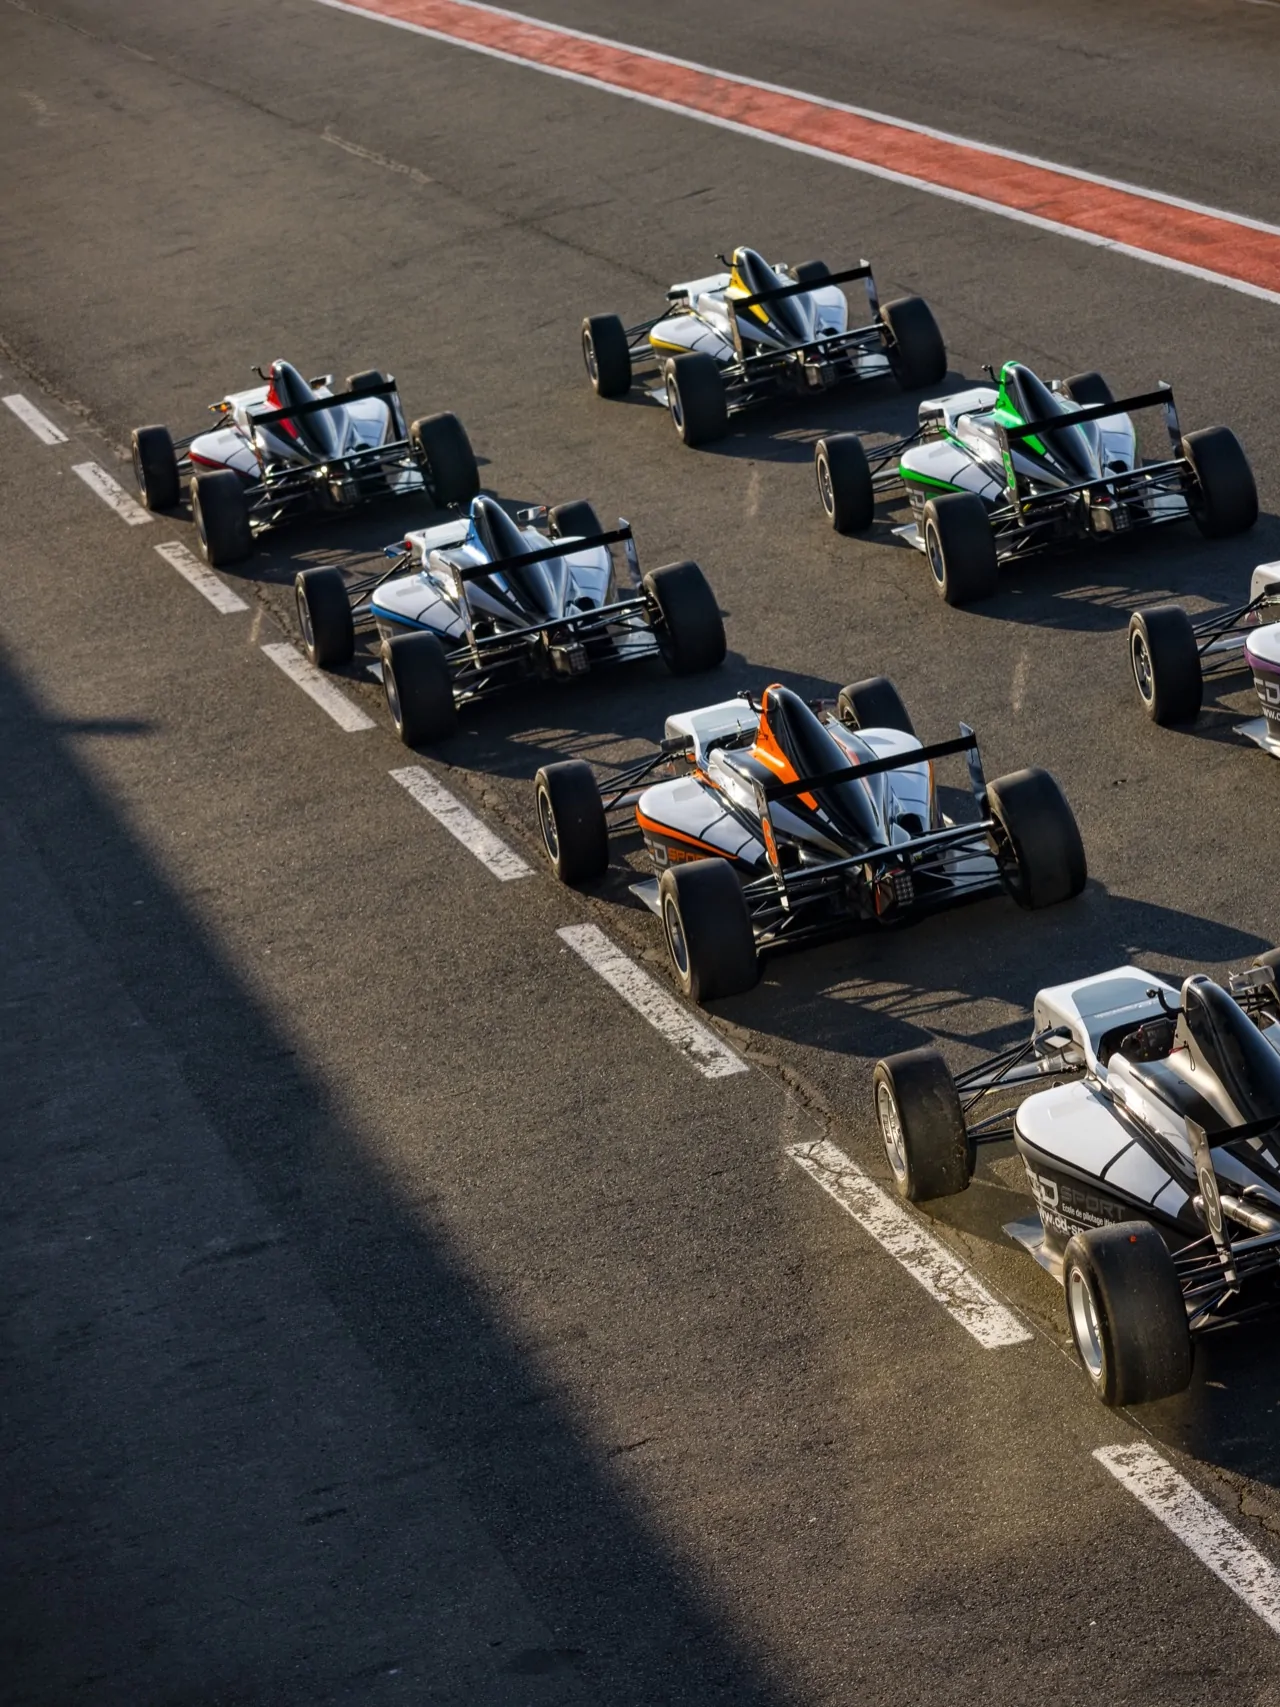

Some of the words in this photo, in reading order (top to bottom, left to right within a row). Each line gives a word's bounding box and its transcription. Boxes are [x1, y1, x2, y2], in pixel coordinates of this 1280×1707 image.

[1253, 677, 1280, 705] CD
[1061, 1185, 1125, 1220] SPORT
[1062, 1203, 1075, 1216] Ecole
[1075, 1208, 1082, 1218] de
[1083, 1211, 1104, 1226] pilotage
